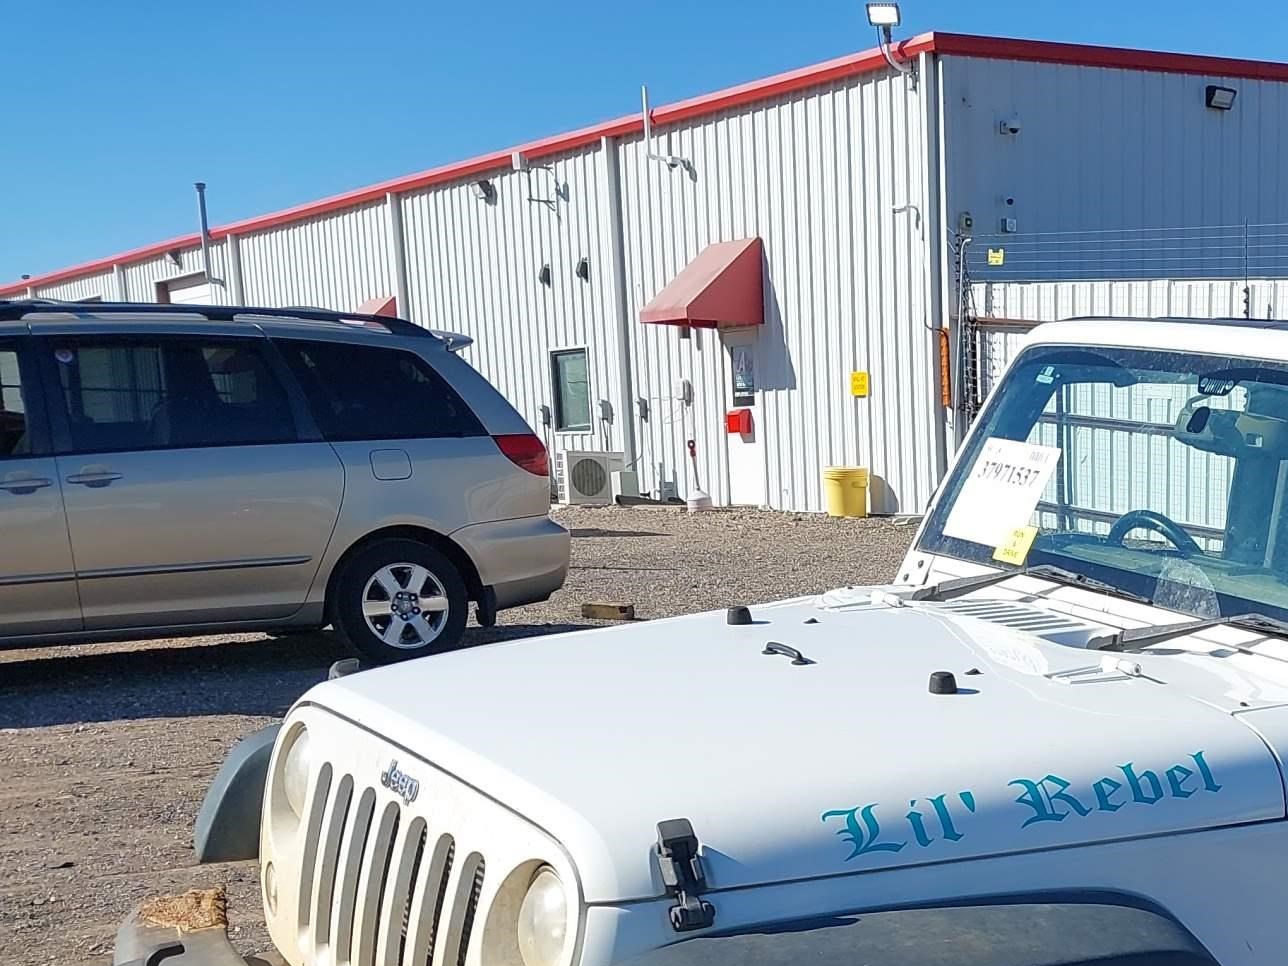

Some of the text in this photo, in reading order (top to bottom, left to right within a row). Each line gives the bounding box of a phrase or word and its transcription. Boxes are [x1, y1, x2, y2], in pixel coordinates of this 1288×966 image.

[978, 460, 1041, 487] 37971537
[381, 759, 420, 807] Jeep
[821, 750, 1223, 862] Lil' Rebel
